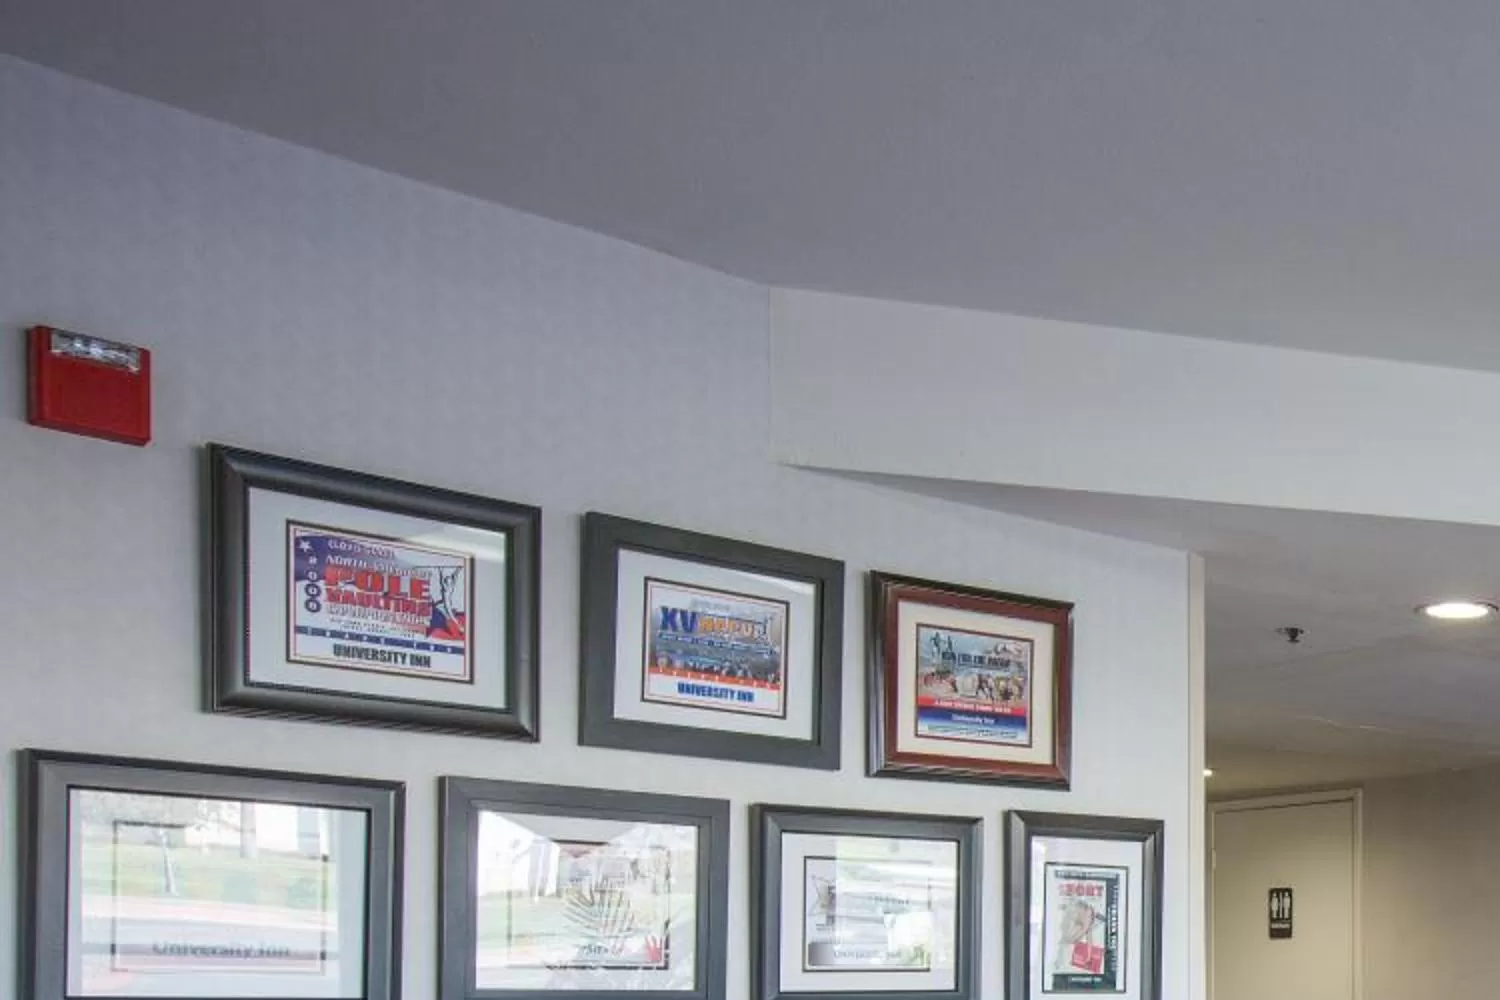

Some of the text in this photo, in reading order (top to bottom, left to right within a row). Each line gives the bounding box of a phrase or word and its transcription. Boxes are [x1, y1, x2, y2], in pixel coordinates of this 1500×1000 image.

[324, 565, 431, 602] POLE
[333, 643, 407, 665] UNIVERSITY
[410, 656, 431, 668] INN
[677, 682, 755, 702] UNIVERSITY INN
